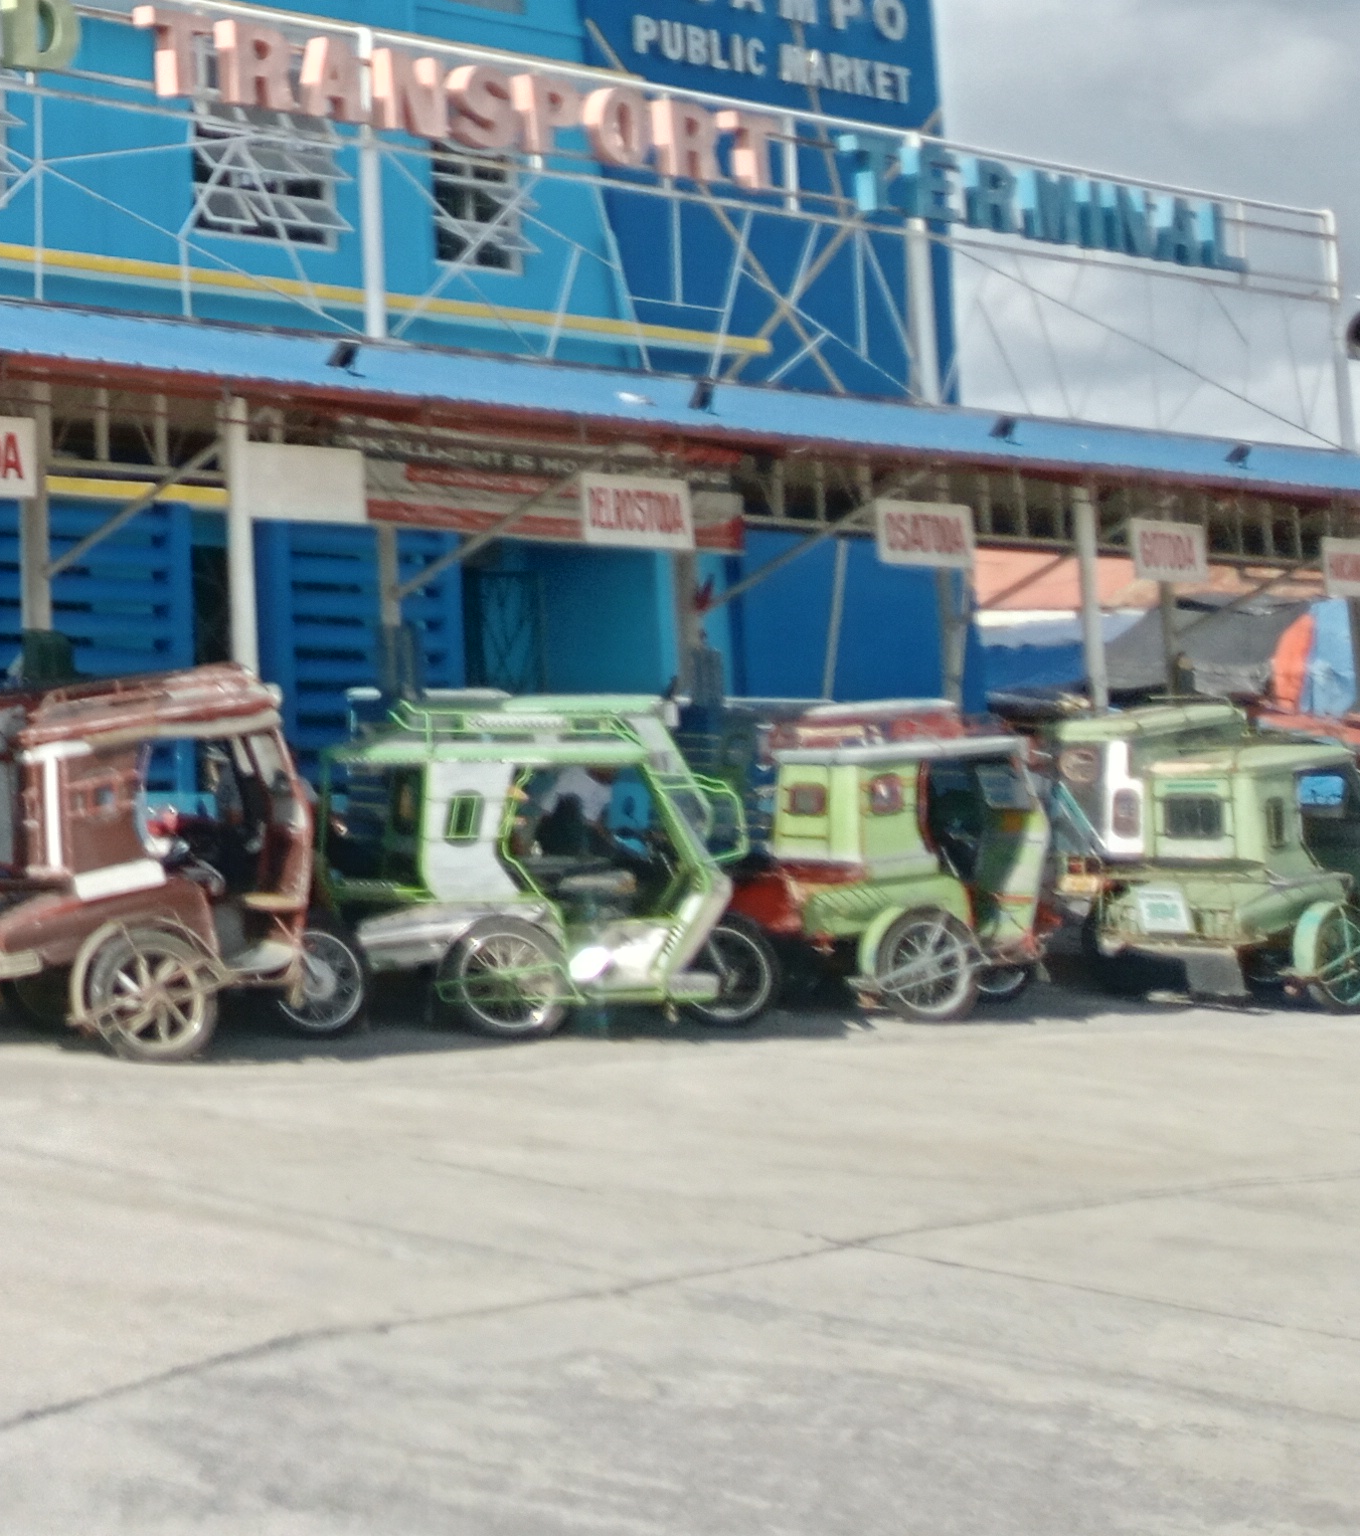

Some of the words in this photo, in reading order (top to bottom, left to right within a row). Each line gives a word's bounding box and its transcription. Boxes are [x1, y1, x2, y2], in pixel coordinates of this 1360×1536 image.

[133, 5, 777, 190] TRANSPORT
[633, 14, 766, 76] PUBLIC
[779, 44, 912, 104] MARKET
